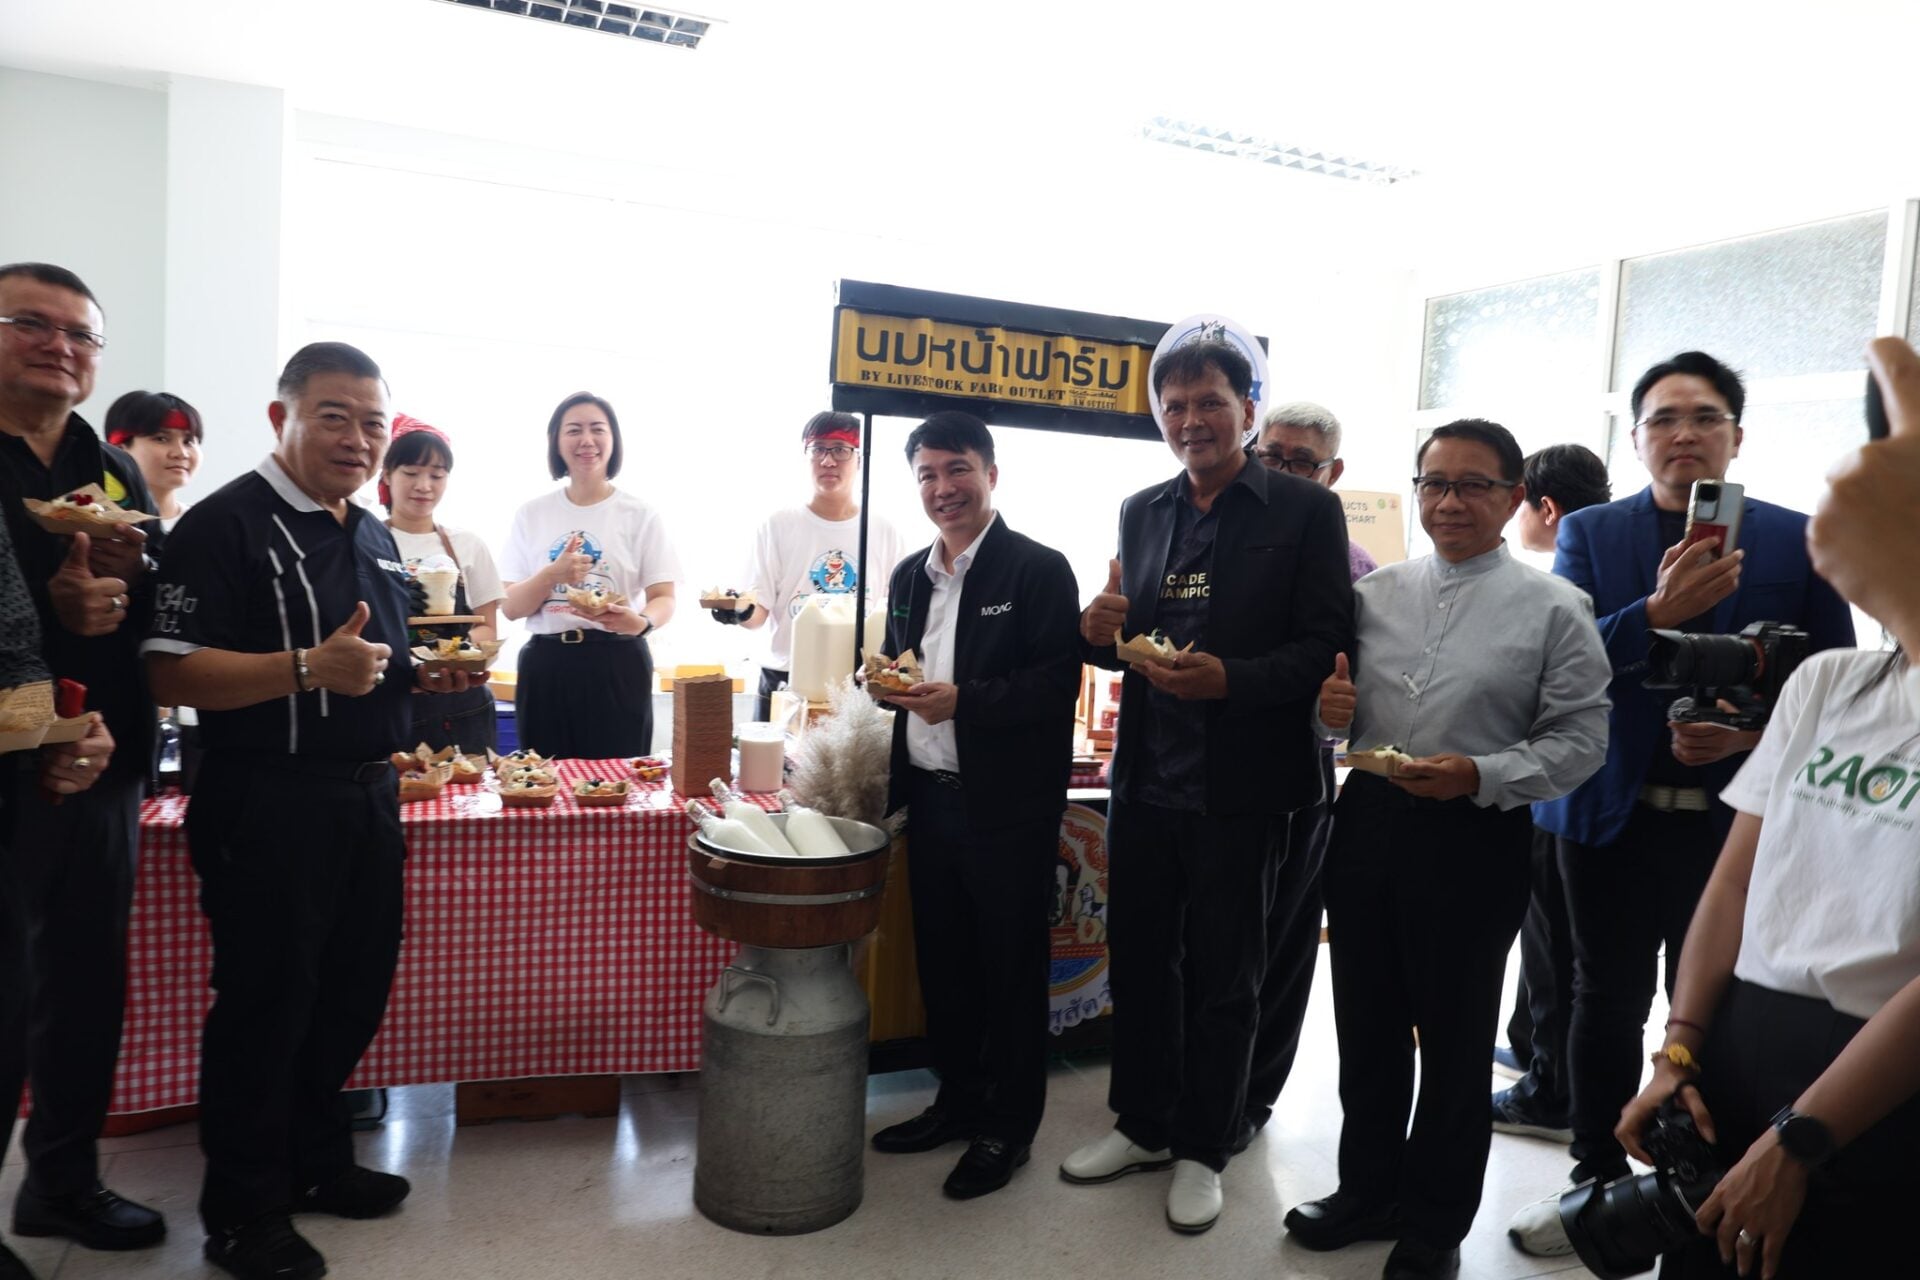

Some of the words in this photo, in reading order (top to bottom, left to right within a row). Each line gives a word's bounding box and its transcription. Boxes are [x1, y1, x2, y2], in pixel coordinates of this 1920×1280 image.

[857, 327, 1129, 389] นมหน้าฟาร์ม
[861, 369, 881, 382] BY
[887, 372, 963, 392] LIVESTOCK
[1009, 386, 1066, 400] OUTLET
[1165, 573, 1207, 586] CADE
